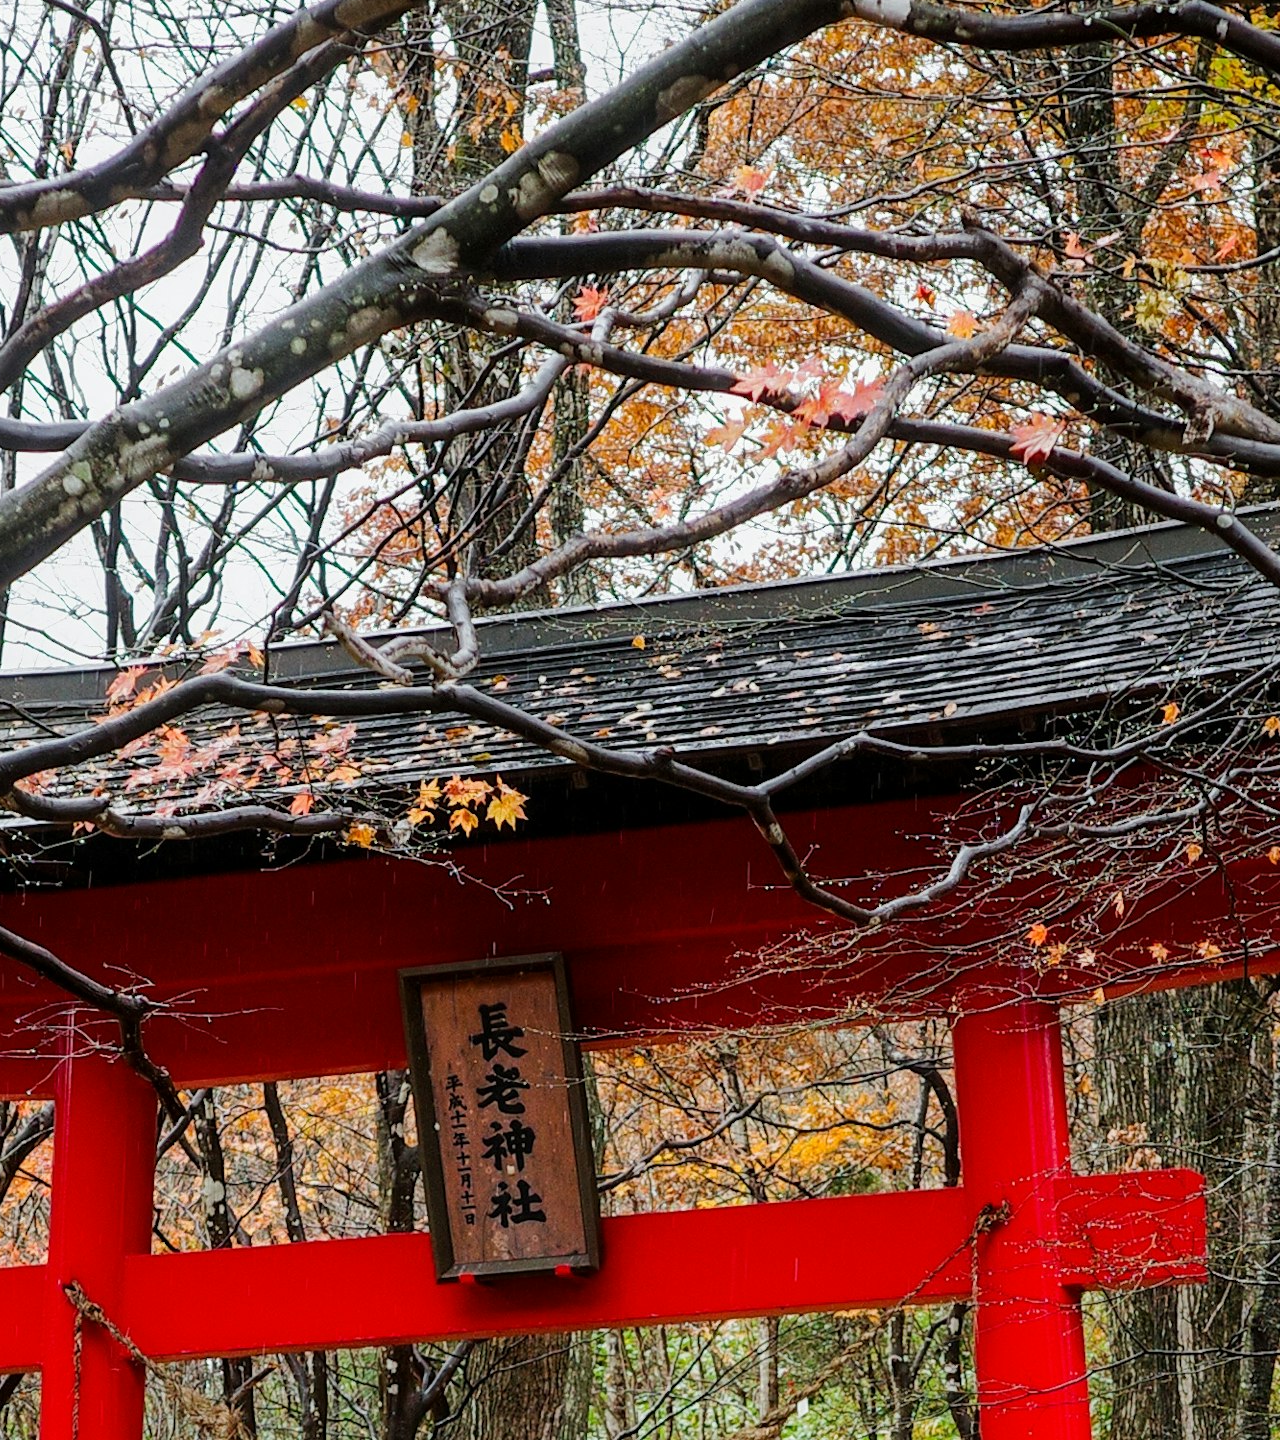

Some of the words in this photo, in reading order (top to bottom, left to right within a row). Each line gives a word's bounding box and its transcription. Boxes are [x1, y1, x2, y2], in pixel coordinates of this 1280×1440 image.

[446, 1074, 476, 1225] 平成十一年十一月十一日
[472, 1002, 547, 1228] 長老神社
